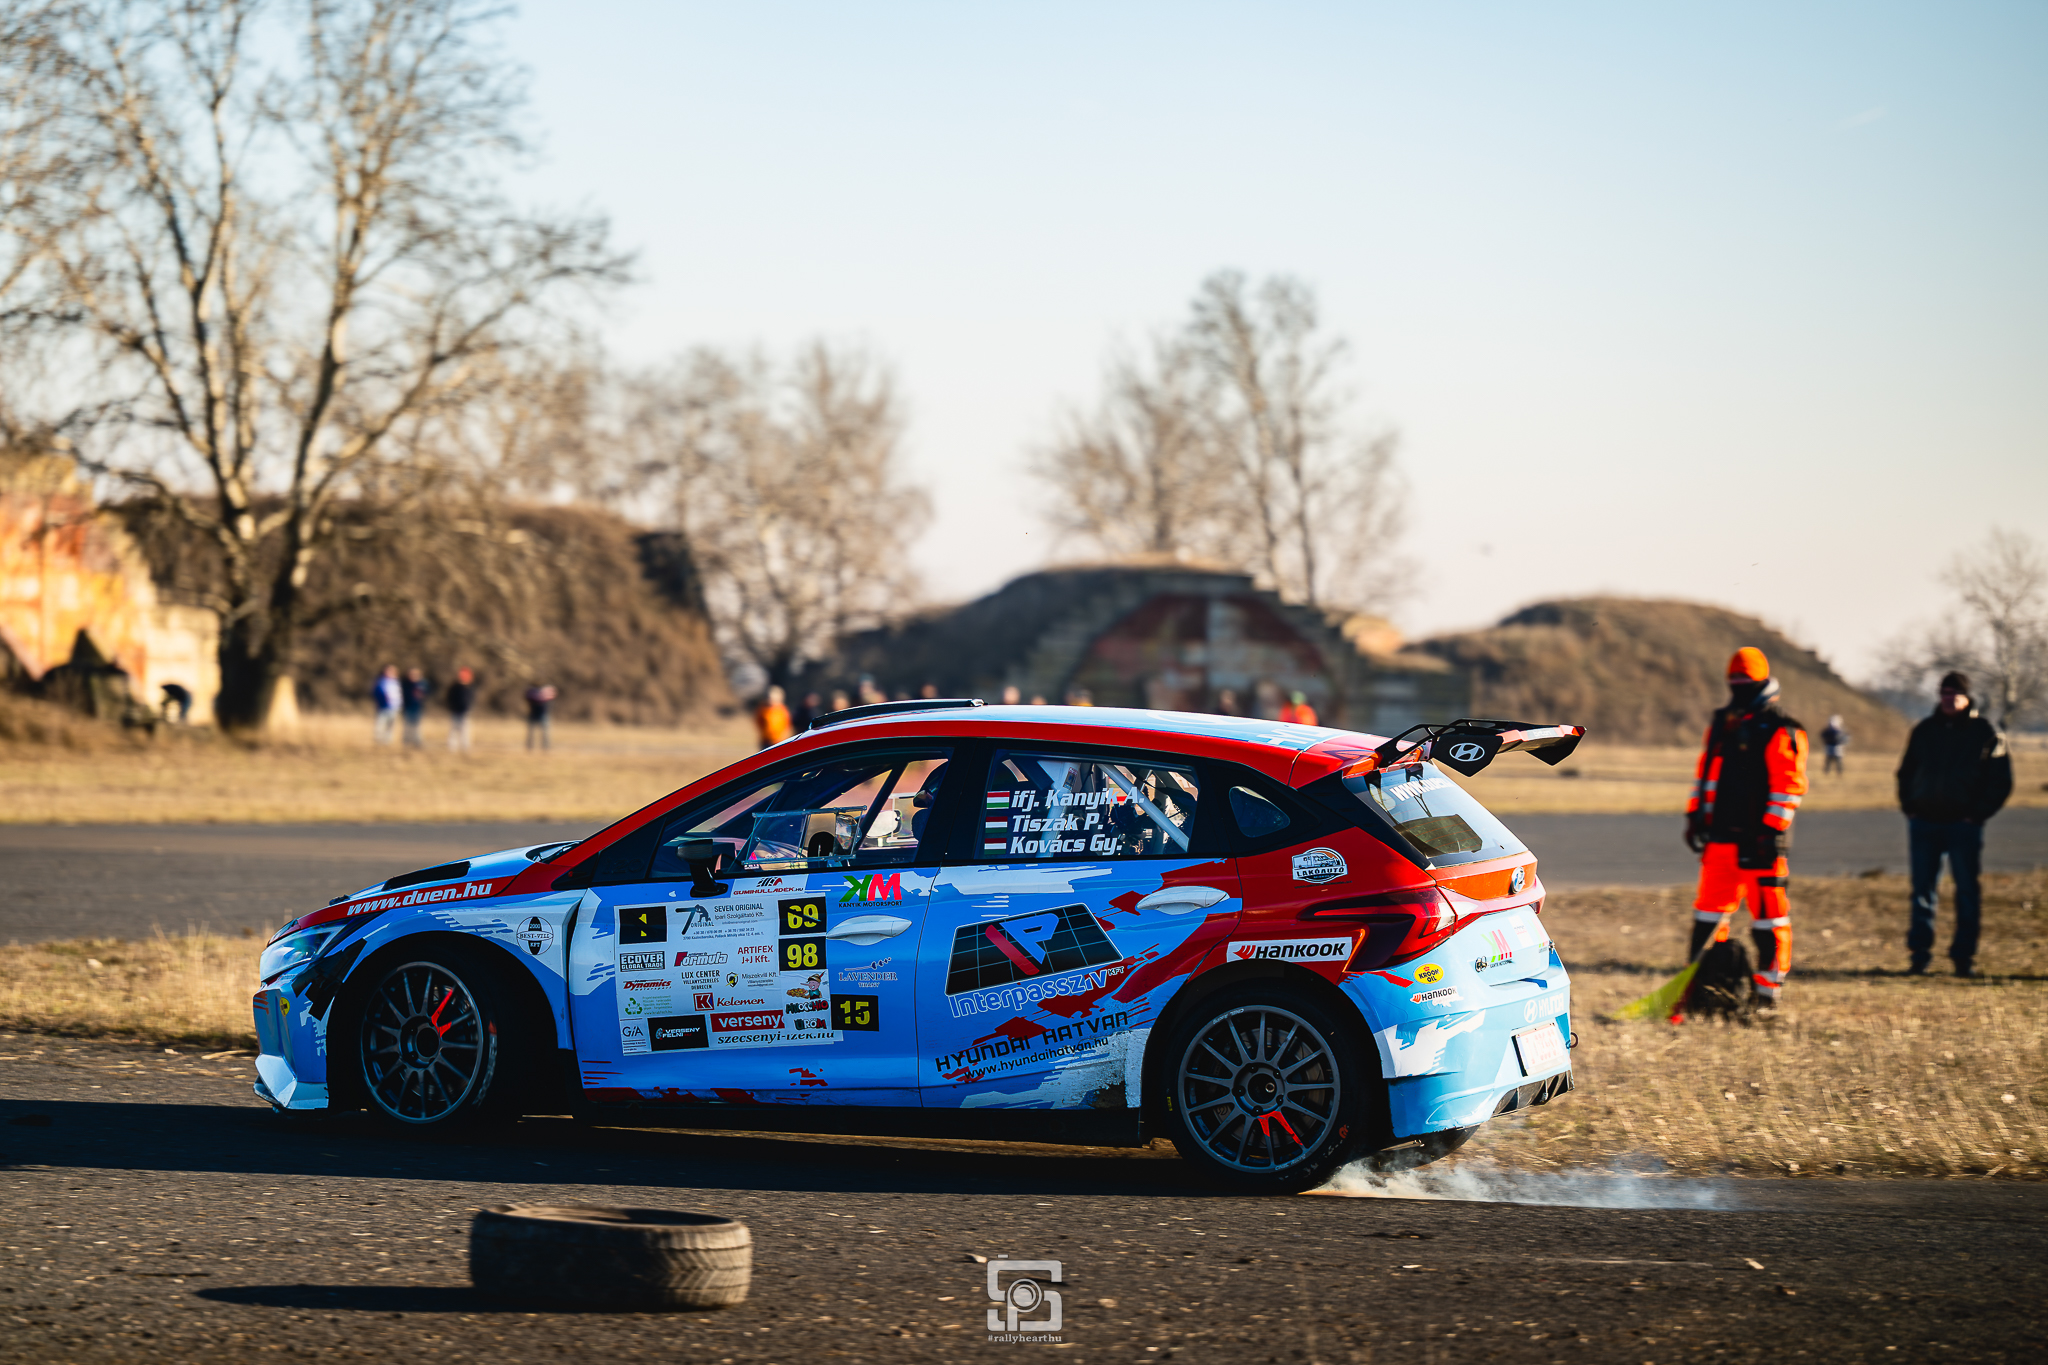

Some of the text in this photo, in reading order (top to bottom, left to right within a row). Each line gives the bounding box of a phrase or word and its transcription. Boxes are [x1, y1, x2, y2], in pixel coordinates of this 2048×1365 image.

[1011, 786, 1145, 812] ifj. Kanyik A.
[1012, 812, 1104, 833] Tiszák P.
[1010, 831, 1123, 856] Kovács Gy.
[347, 881, 493, 916] www.duen.hu
[714, 903, 764, 913] SEVEN ORIGINAL
[737, 945, 774, 955] ARTIFEX
[787, 943, 818, 968] 98
[621, 953, 664, 965] ECOVER
[674, 951, 729, 967] Formula
[741, 955, 770, 964] J+J Kft.
[681, 970, 721, 979] LUX CENTER
[838, 972, 899, 982] LAVENDER
[1108, 966, 1125, 977] KFT
[623, 978, 672, 991] Dynamics
[716, 996, 766, 1007] Kelemen
[840, 1000, 870, 1025] 15
[719, 1014, 784, 1029] verseny
[935, 1011, 1129, 1072] HYUNDAI HATVAN
[963, 1036, 1109, 1080] www.hyundaihatvan.hu
